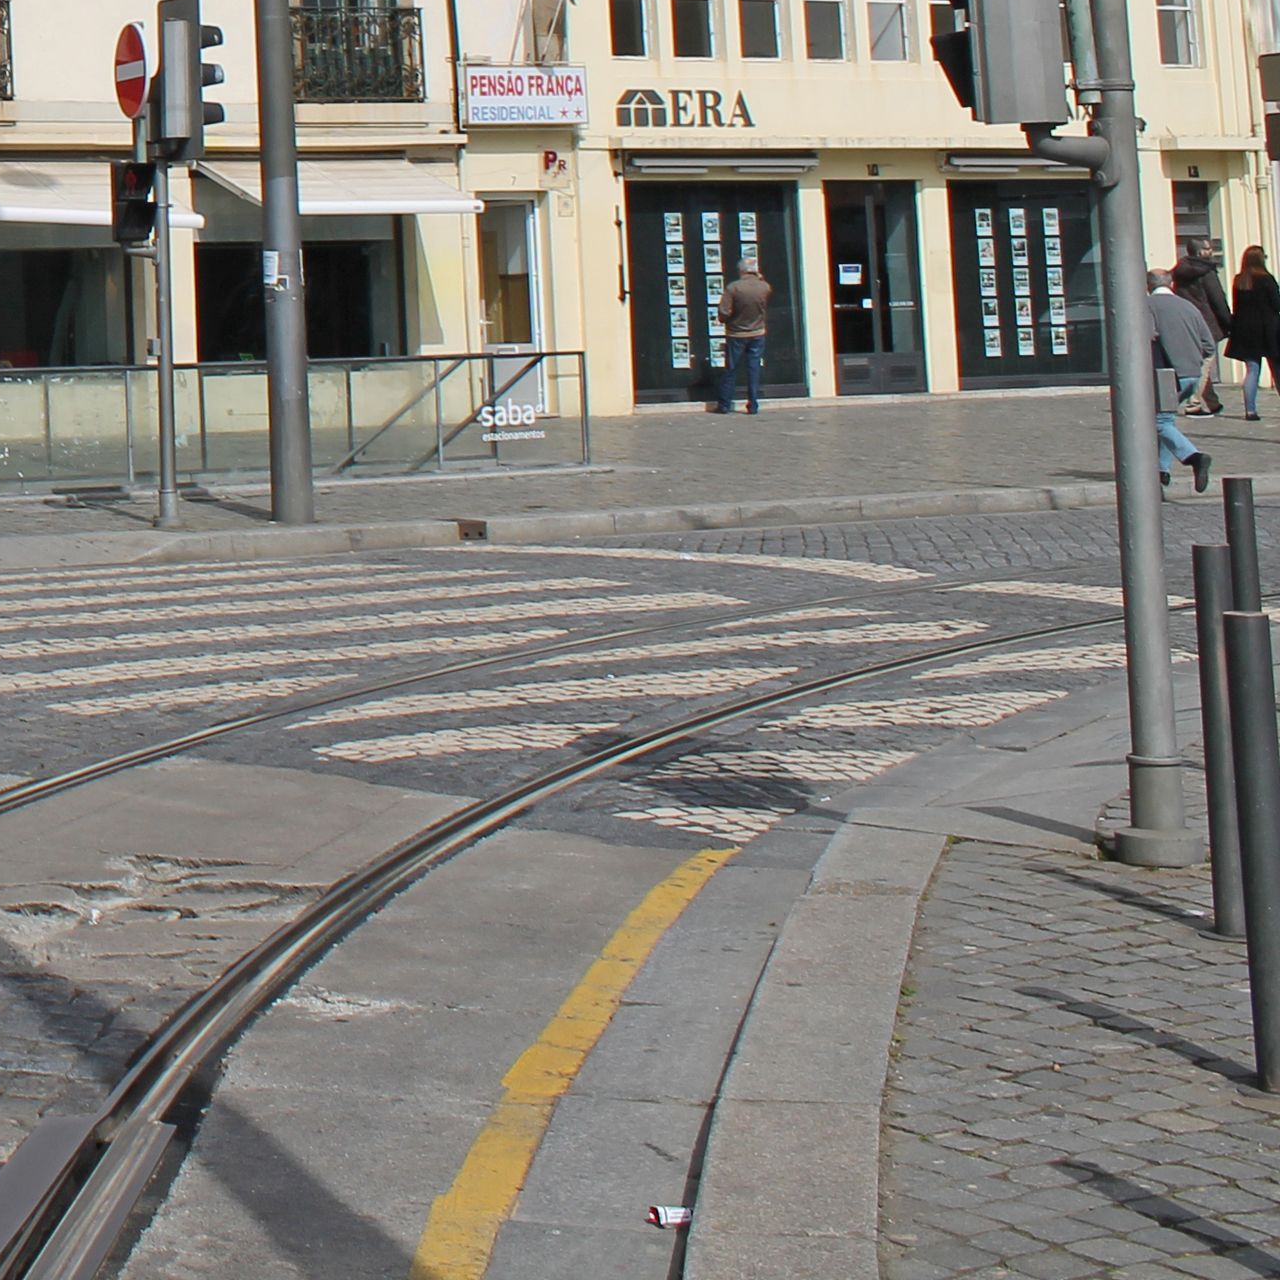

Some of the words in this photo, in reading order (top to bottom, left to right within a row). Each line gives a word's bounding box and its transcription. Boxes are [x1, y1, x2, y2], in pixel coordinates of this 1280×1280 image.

[470, 70, 524, 96] PENSÃO
[527, 75, 584, 101] FRANÇA
[471, 105, 554, 121] RESIDENCIAL
[668, 89, 756, 128] ERA
[481, 398, 535, 427] saba
[482, 430, 546, 442] estacionamentos
